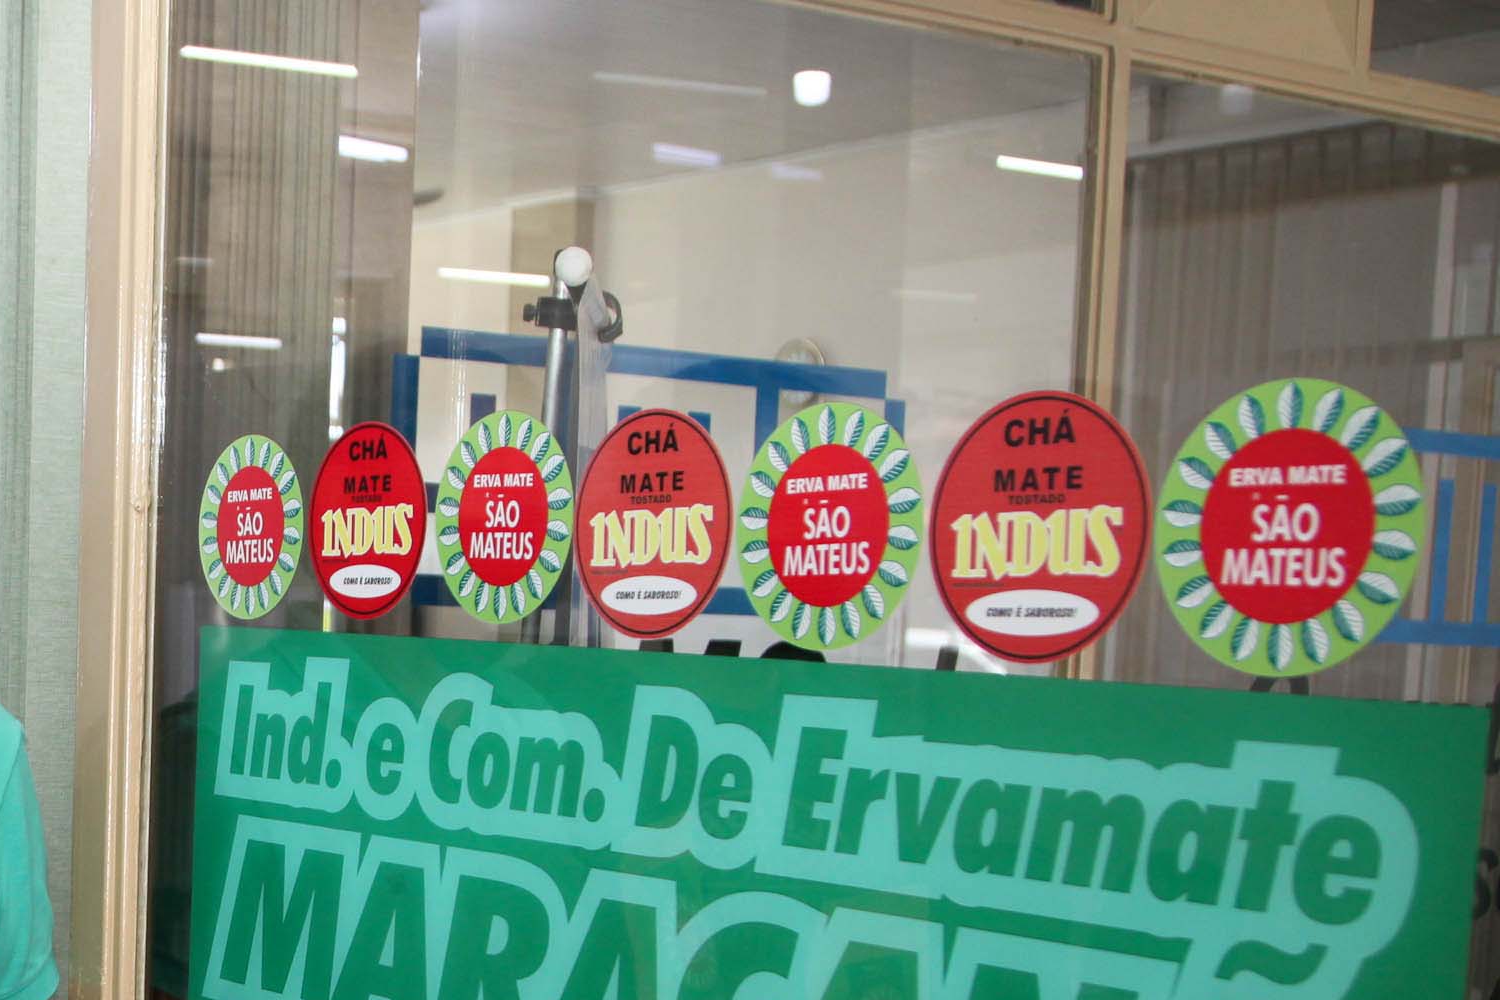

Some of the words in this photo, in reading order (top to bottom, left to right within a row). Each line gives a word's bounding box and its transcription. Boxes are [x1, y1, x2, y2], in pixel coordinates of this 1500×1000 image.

[627, 423, 679, 455] CHÁ
[1004, 408, 1076, 448] CHÁ
[349, 433, 388, 461] CHÁ
[344, 475, 392, 494] MATE
[473, 473, 501, 488] ERVA
[503, 472, 533, 487] MATE
[620, 471, 684, 493] MATE
[786, 477, 824, 495] ERVA
[827, 472, 868, 491] MATE
[994, 466, 1083, 492] MATE
[1229, 466, 1283, 488] ERVA
[1288, 464, 1346, 485] MATE
[228, 489, 248, 503] ERVA
[250, 487, 273, 501] MATE
[485, 492, 520, 528] SÃO
[237, 506, 263, 537] SÃO
[321, 503, 413, 558] INDUS
[803, 499, 851, 540] SÃO
[1252, 494, 1320, 542] SÃO
[469, 531, 533, 560] MATEUS
[589, 503, 713, 568] INDUS
[951, 504, 1123, 580] INDUS
[226, 538, 274, 564] MATEUS
[784, 541, 870, 576] MATEUS
[1221, 547, 1345, 588] MATEUS
[616, 591, 635, 599] COMO
[986, 606, 1012, 618] COMO
[230, 682, 341, 789] Ind.
[366, 723, 404, 796] e
[429, 699, 605, 823] Com.
[635, 714, 752, 840] De
[781, 726, 1381, 926] Ervamate
